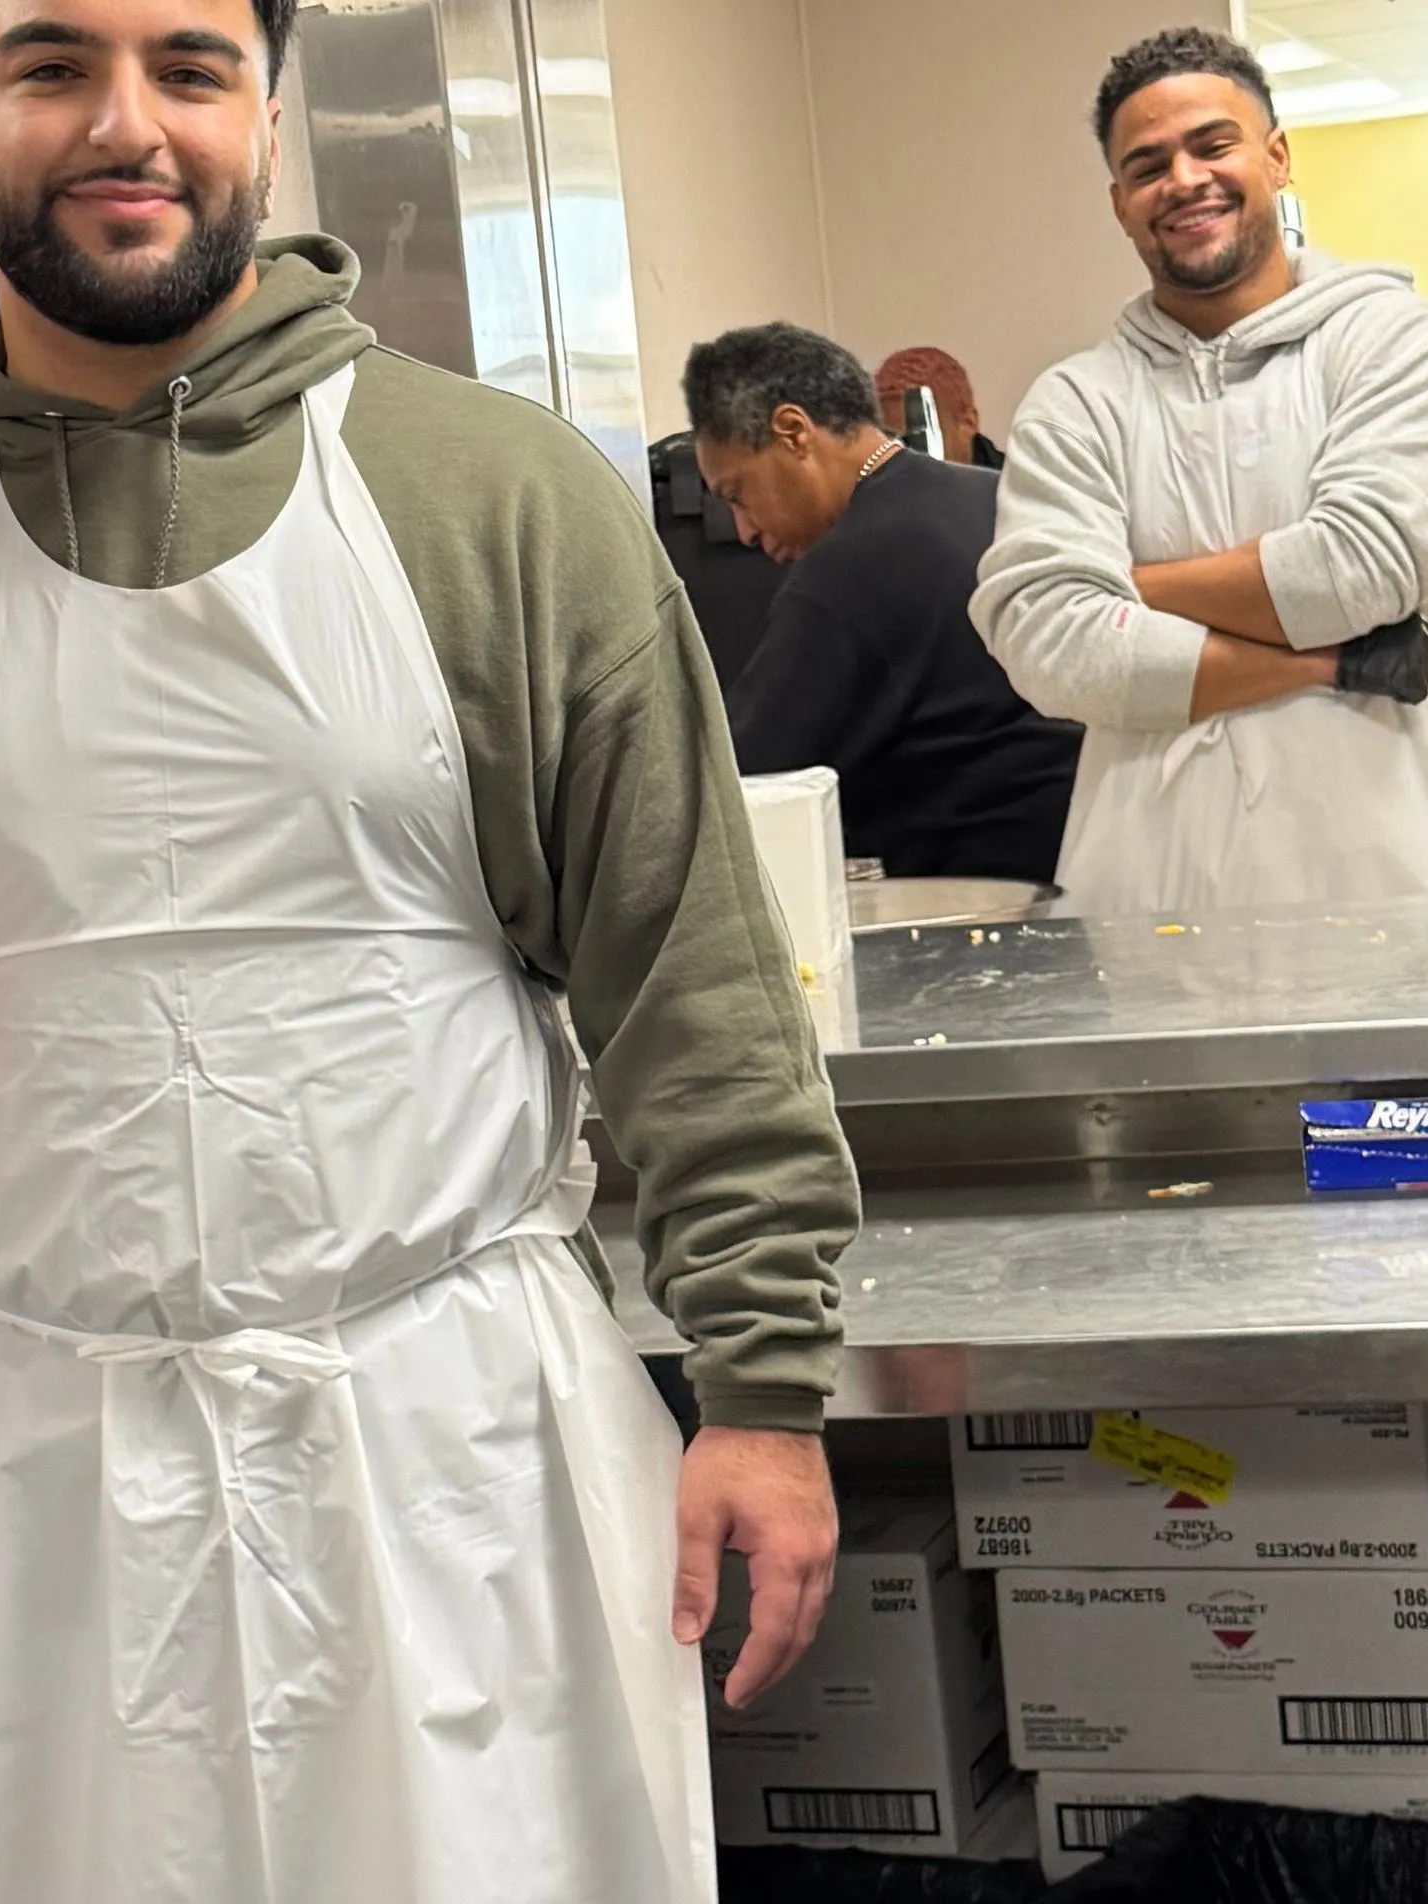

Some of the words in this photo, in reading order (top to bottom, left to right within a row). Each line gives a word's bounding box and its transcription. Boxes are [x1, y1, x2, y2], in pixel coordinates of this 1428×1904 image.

[974, 1516, 1032, 1534] 00972
[977, 1538, 1033, 1556] 18687
[1255, 1542, 1335, 1558] PACKETS
[1011, 1588, 1085, 1606] 2000-2.8g
[1088, 1587, 1166, 1604] PACKETS
